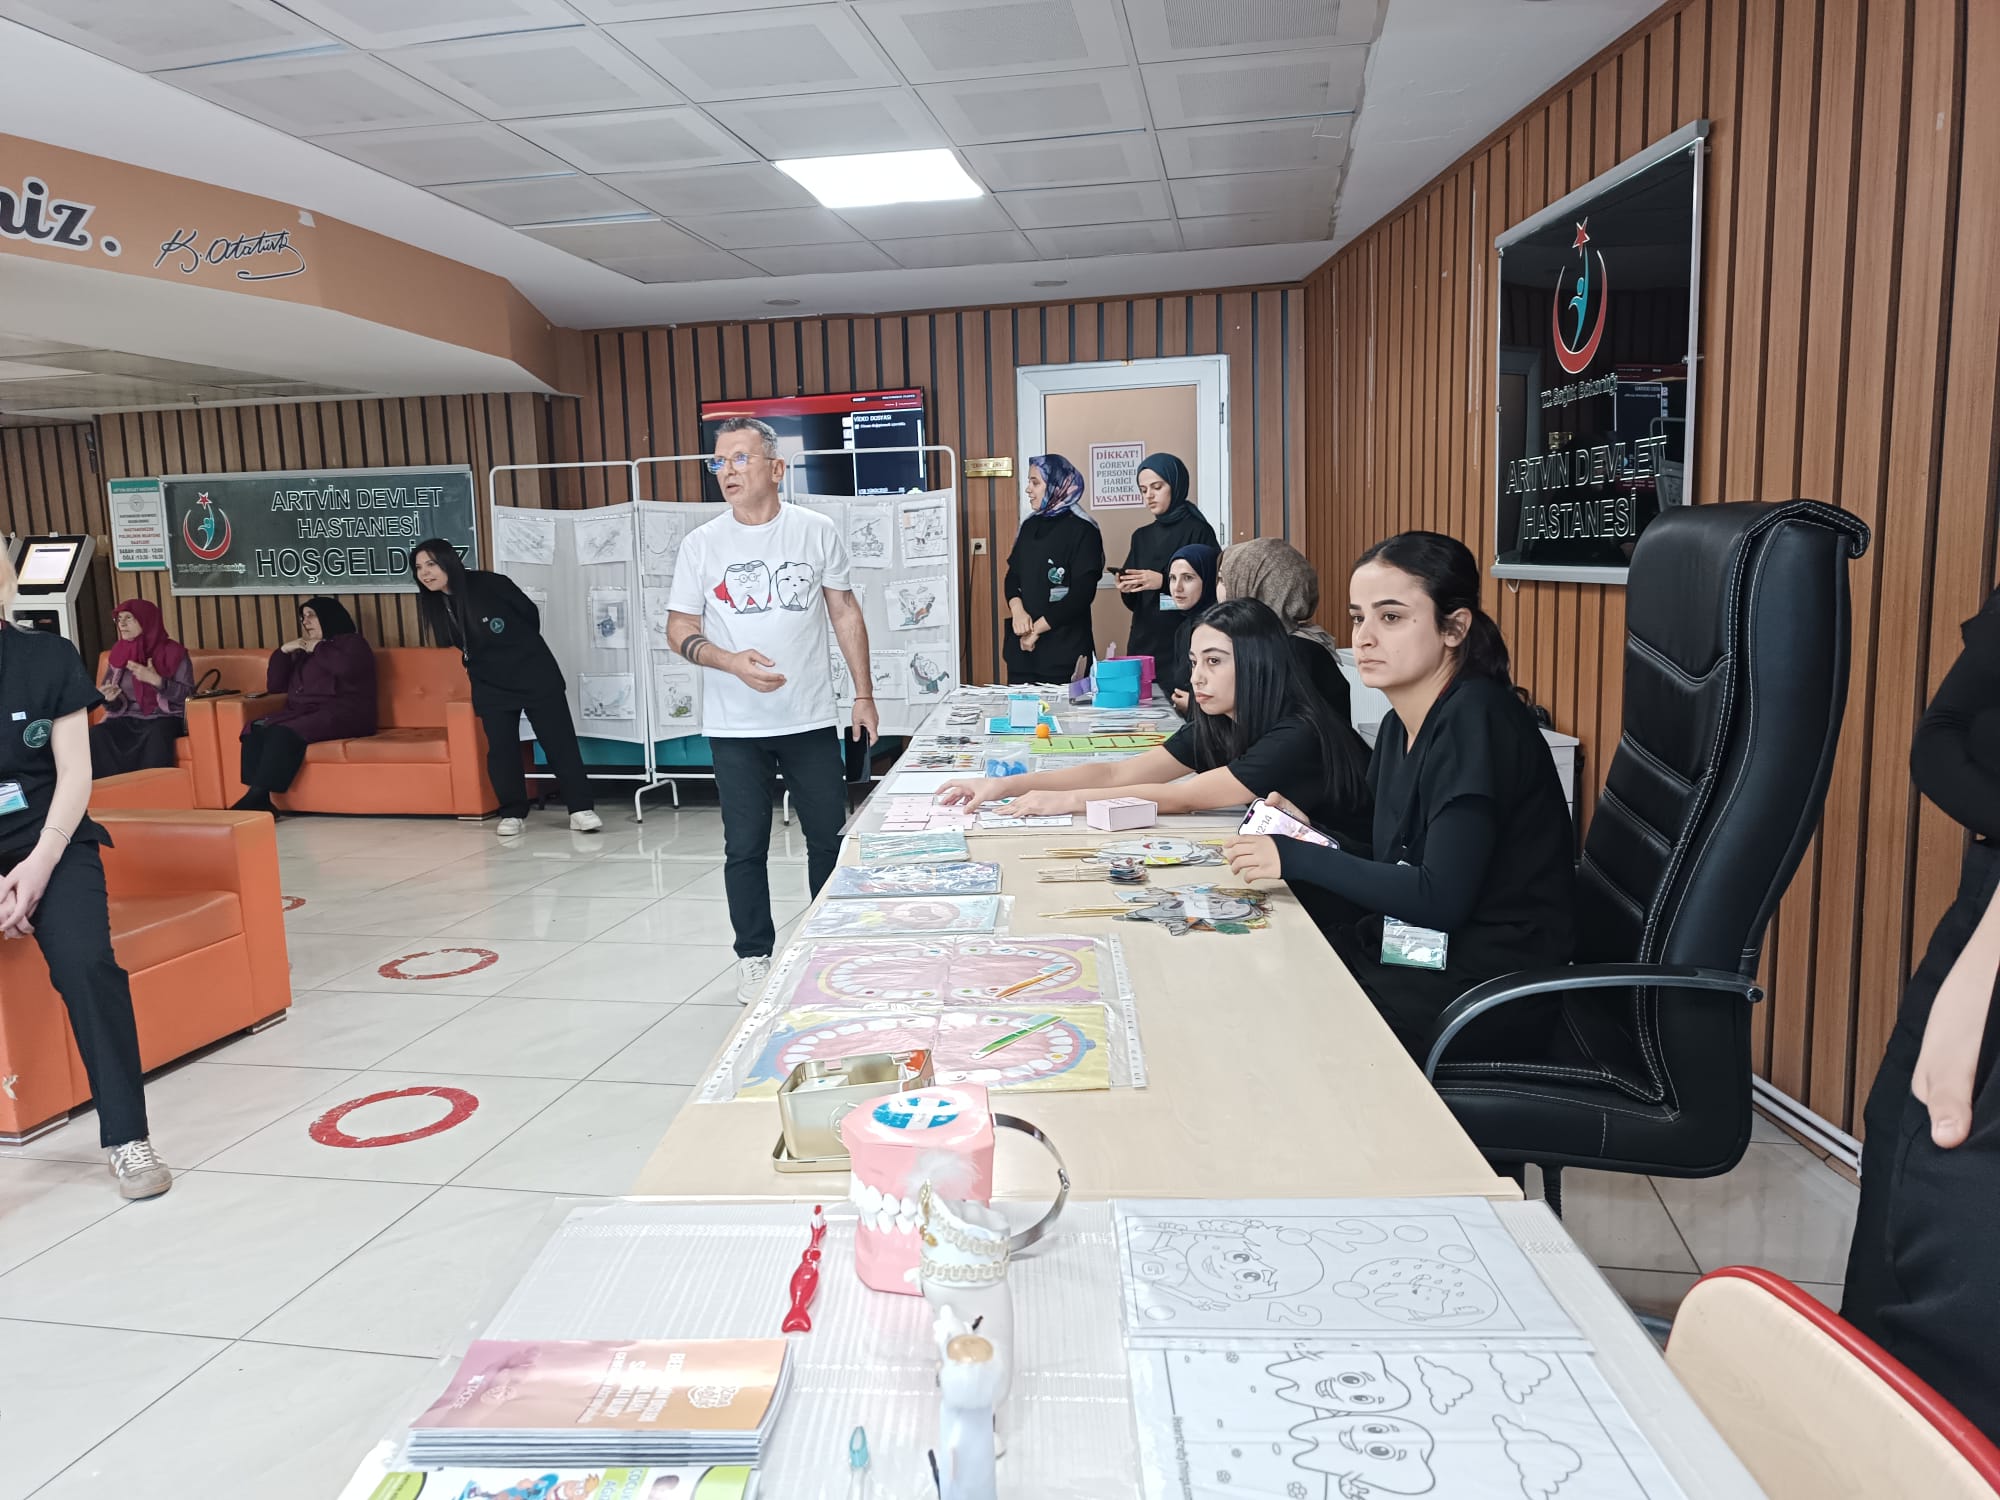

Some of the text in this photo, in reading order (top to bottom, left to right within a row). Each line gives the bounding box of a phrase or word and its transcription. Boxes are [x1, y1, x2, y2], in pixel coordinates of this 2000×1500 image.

[1096, 449, 1139, 460] DİKKAT!
[1099, 460, 1135, 470] GÖREVLİ
[1505, 434, 1668, 494] ARTVİN DEVLET
[1101, 485, 1134, 494] GİRMEK
[1103, 476, 1132, 486] HARİCİ
[271, 485, 443, 511] ARTVİN DEVLET
[1095, 494, 1142, 503] YASAKTIR
[1523, 487, 1637, 539] HASTANESİ
[297, 511, 421, 538] HASTANESİ
[255, 539, 470, 584] HOŞGELDZ
